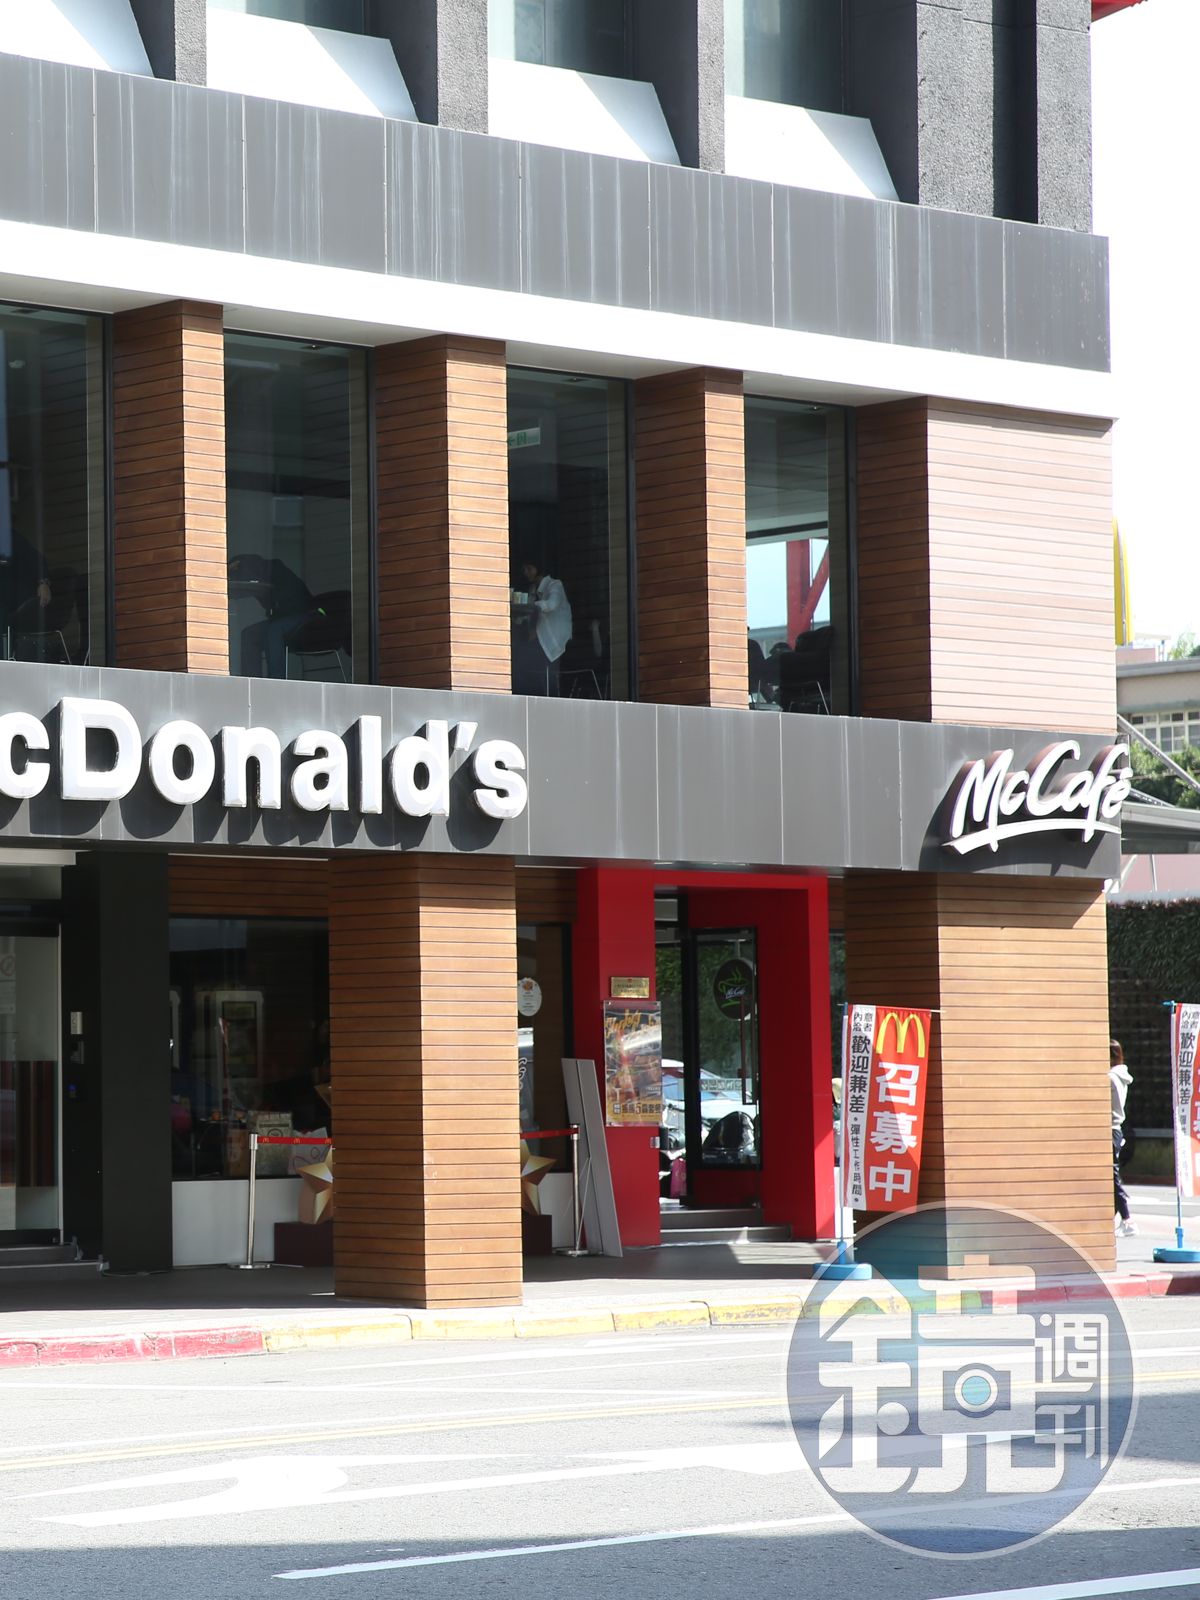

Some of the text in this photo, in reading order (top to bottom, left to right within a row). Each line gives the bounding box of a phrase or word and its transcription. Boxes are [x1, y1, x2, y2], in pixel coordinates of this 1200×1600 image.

[942, 740, 1134, 855] McCafé
[868, 1062, 920, 1203] 召募中
